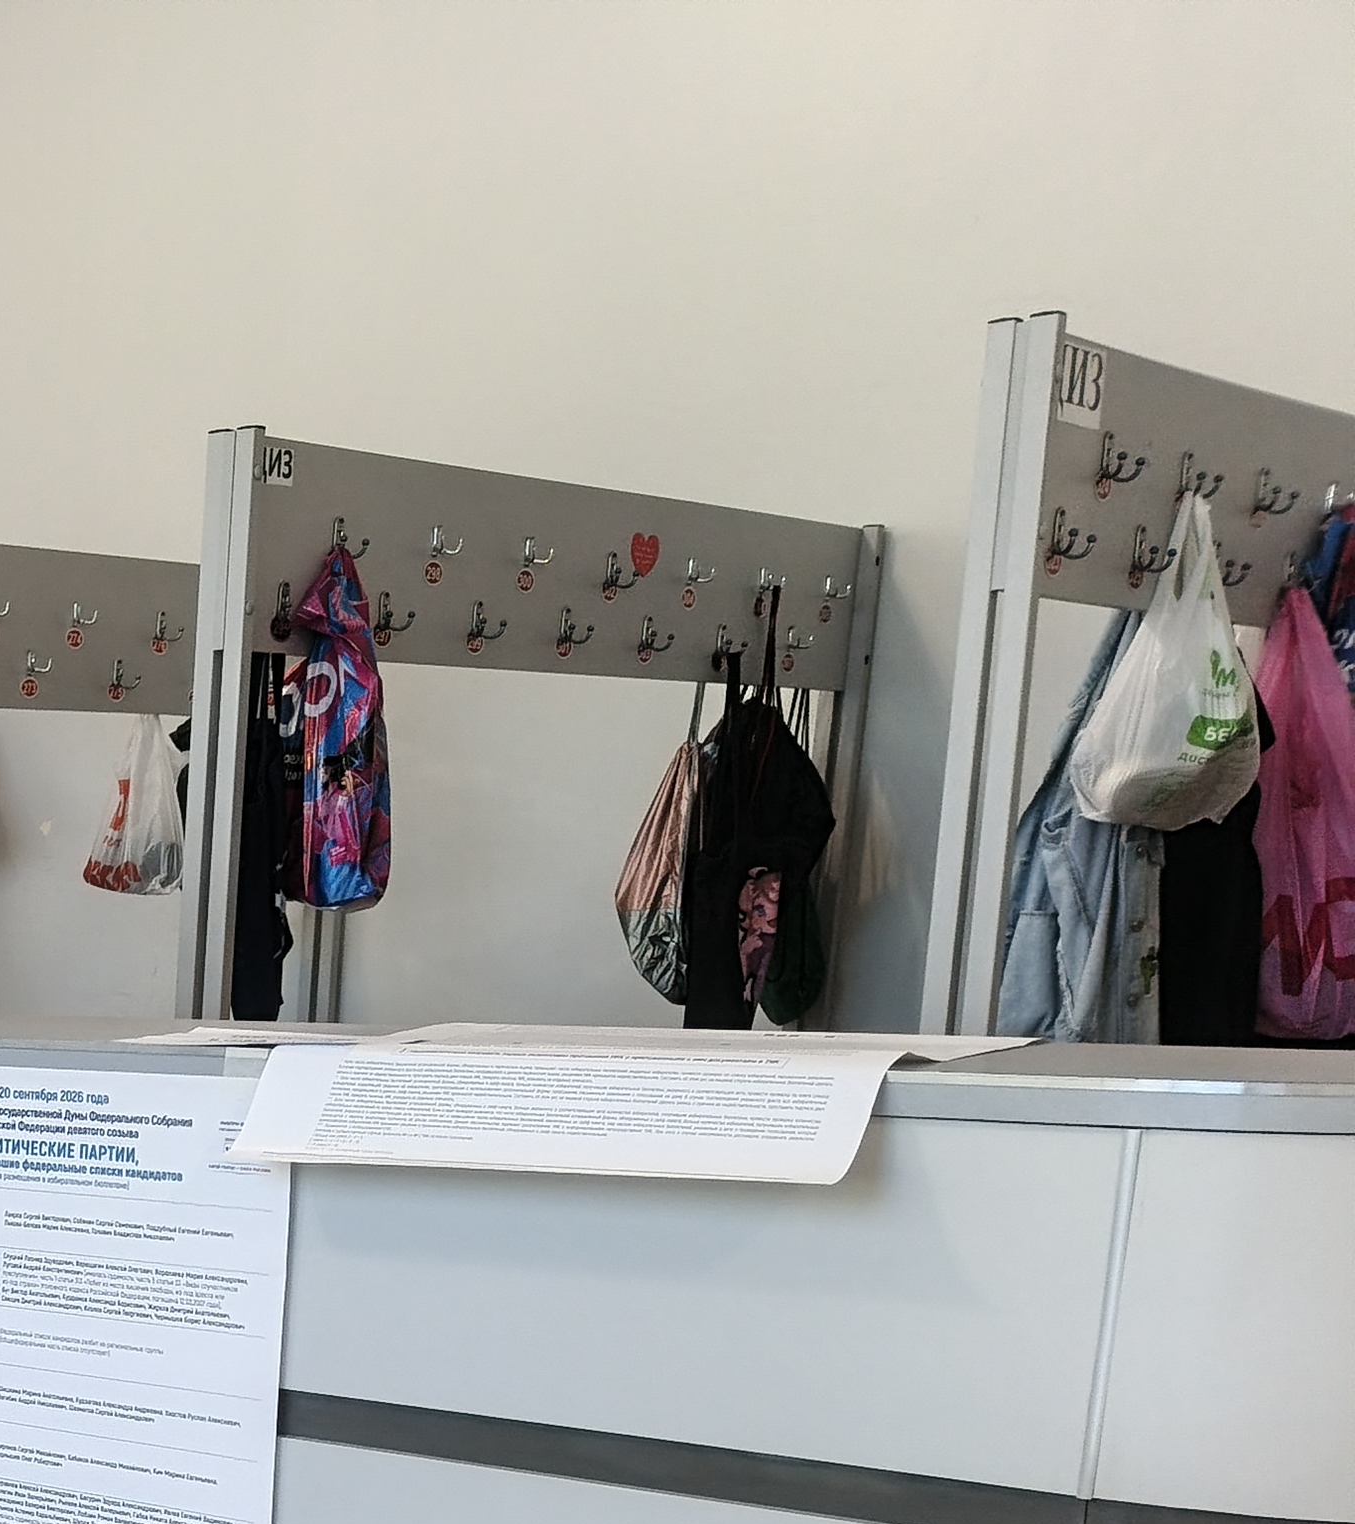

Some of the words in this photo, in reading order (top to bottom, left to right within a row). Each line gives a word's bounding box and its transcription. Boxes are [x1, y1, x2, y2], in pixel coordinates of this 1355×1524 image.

[13, 1088, 58, 1103] сентября
[60, 1090, 84, 1104] 2026
[86, 1094, 109, 1105] года
[63, 1110, 88, 1122] Думы
[89, 1111, 150, 1125] Федерального
[151, 1115, 193, 1128] Собрания
[18, 1121, 66, 1135] Федерации
[67, 1126, 105, 1138] девятого
[107, 1129, 139, 1139] созыва
[79, 1143, 140, 1165] ПАРТИИ,
[22, 1160, 87, 1175] федеральные
[89, 1165, 124, 1178] списки
[125, 1168, 183, 1182] кандидатов
